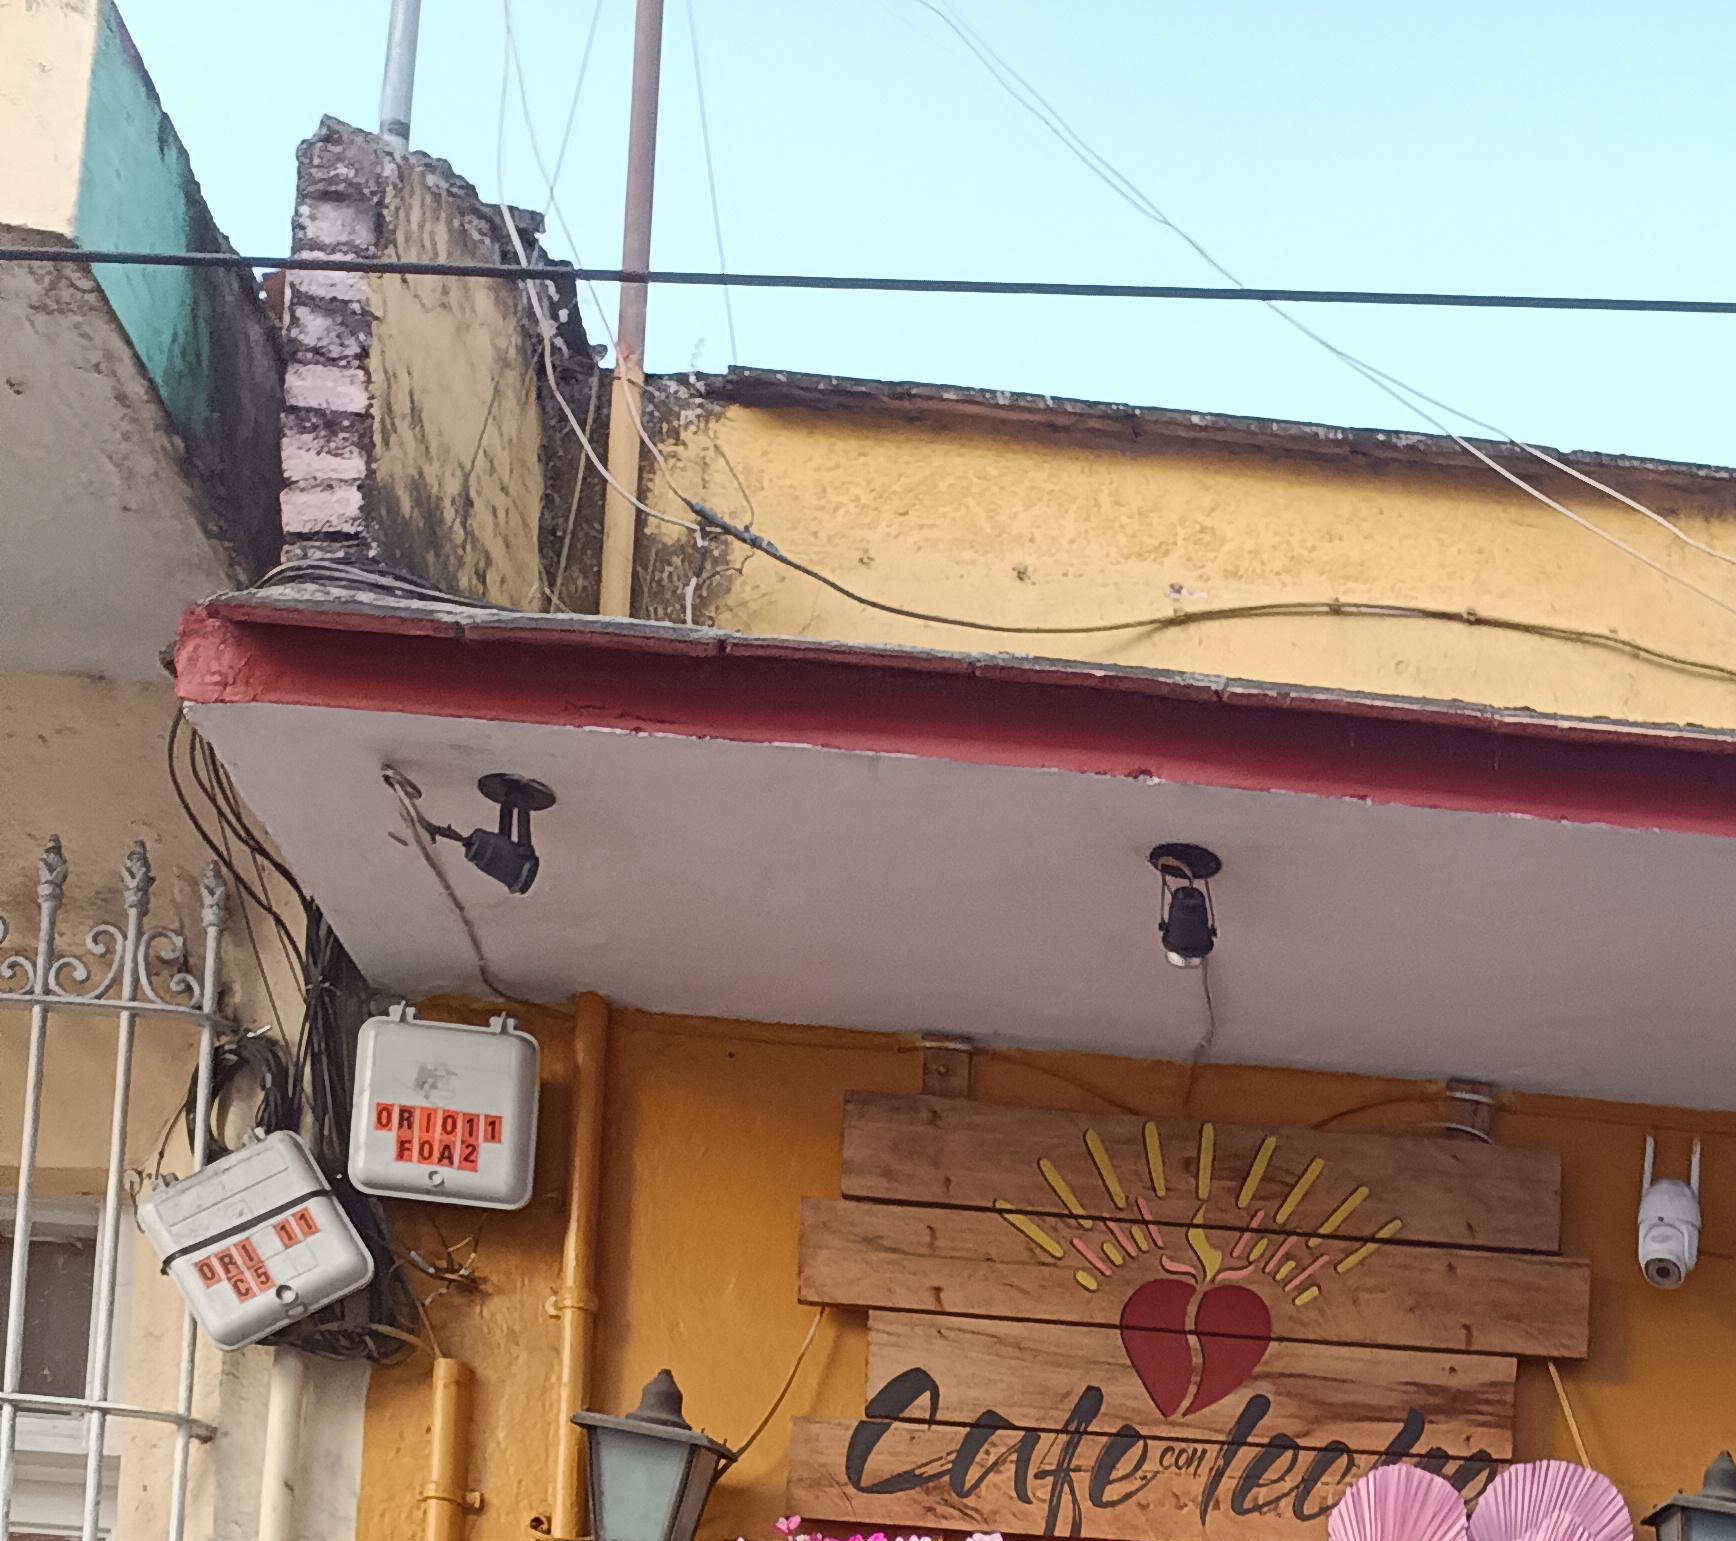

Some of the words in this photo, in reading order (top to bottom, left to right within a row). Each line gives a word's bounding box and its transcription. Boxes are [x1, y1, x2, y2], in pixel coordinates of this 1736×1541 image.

[279, 1212, 313, 1242] 11
[232, 1264, 270, 1297] C5
[845, 1366, 1158, 1538] Cafe
[1158, 1444, 1208, 1479] con
